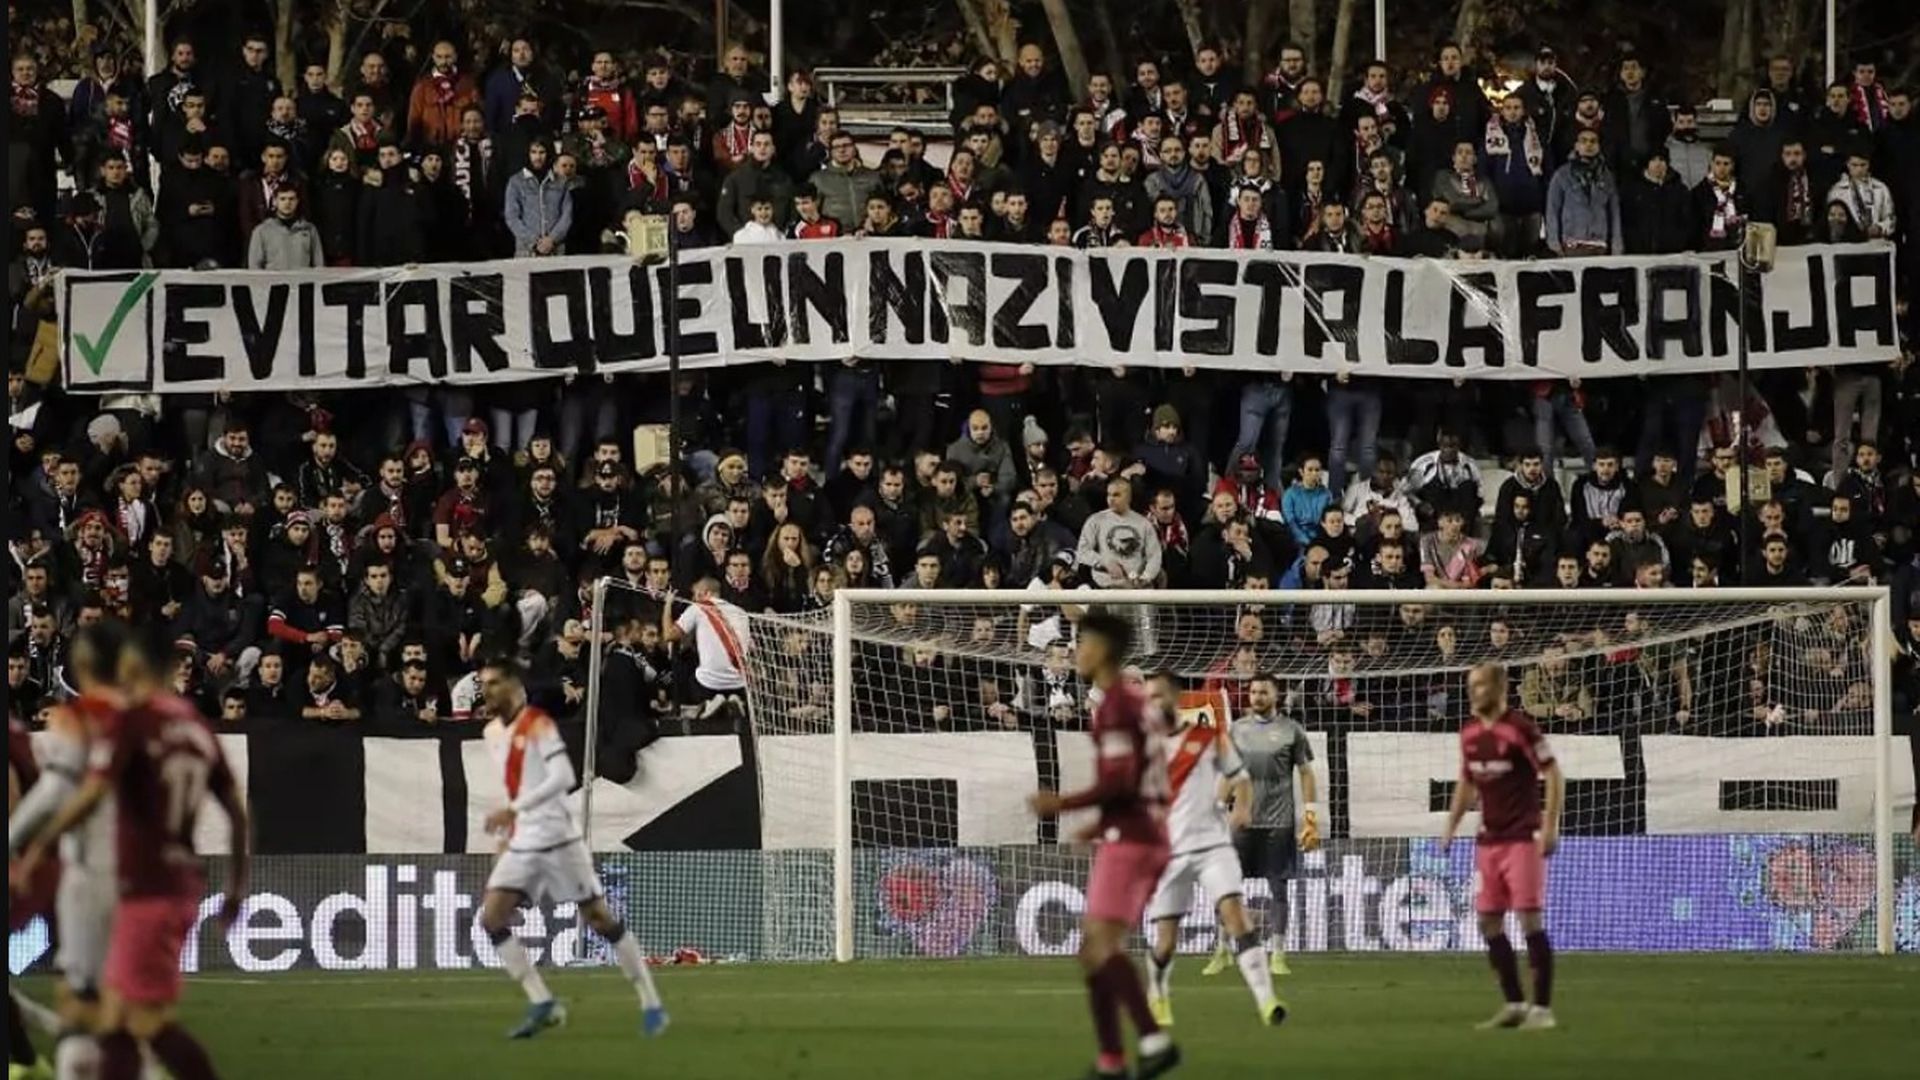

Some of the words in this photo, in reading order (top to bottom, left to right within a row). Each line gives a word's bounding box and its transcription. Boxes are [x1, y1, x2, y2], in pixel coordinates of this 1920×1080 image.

[163, 273, 511, 382] EVITAR
[529, 261, 718, 373] QUE
[727, 251, 849, 350] UN
[868, 249, 1075, 349] NAZI
[1090, 257, 1364, 363] VISTA
[1384, 268, 1504, 368] LA
[1516, 252, 1895, 367] FRANJA
